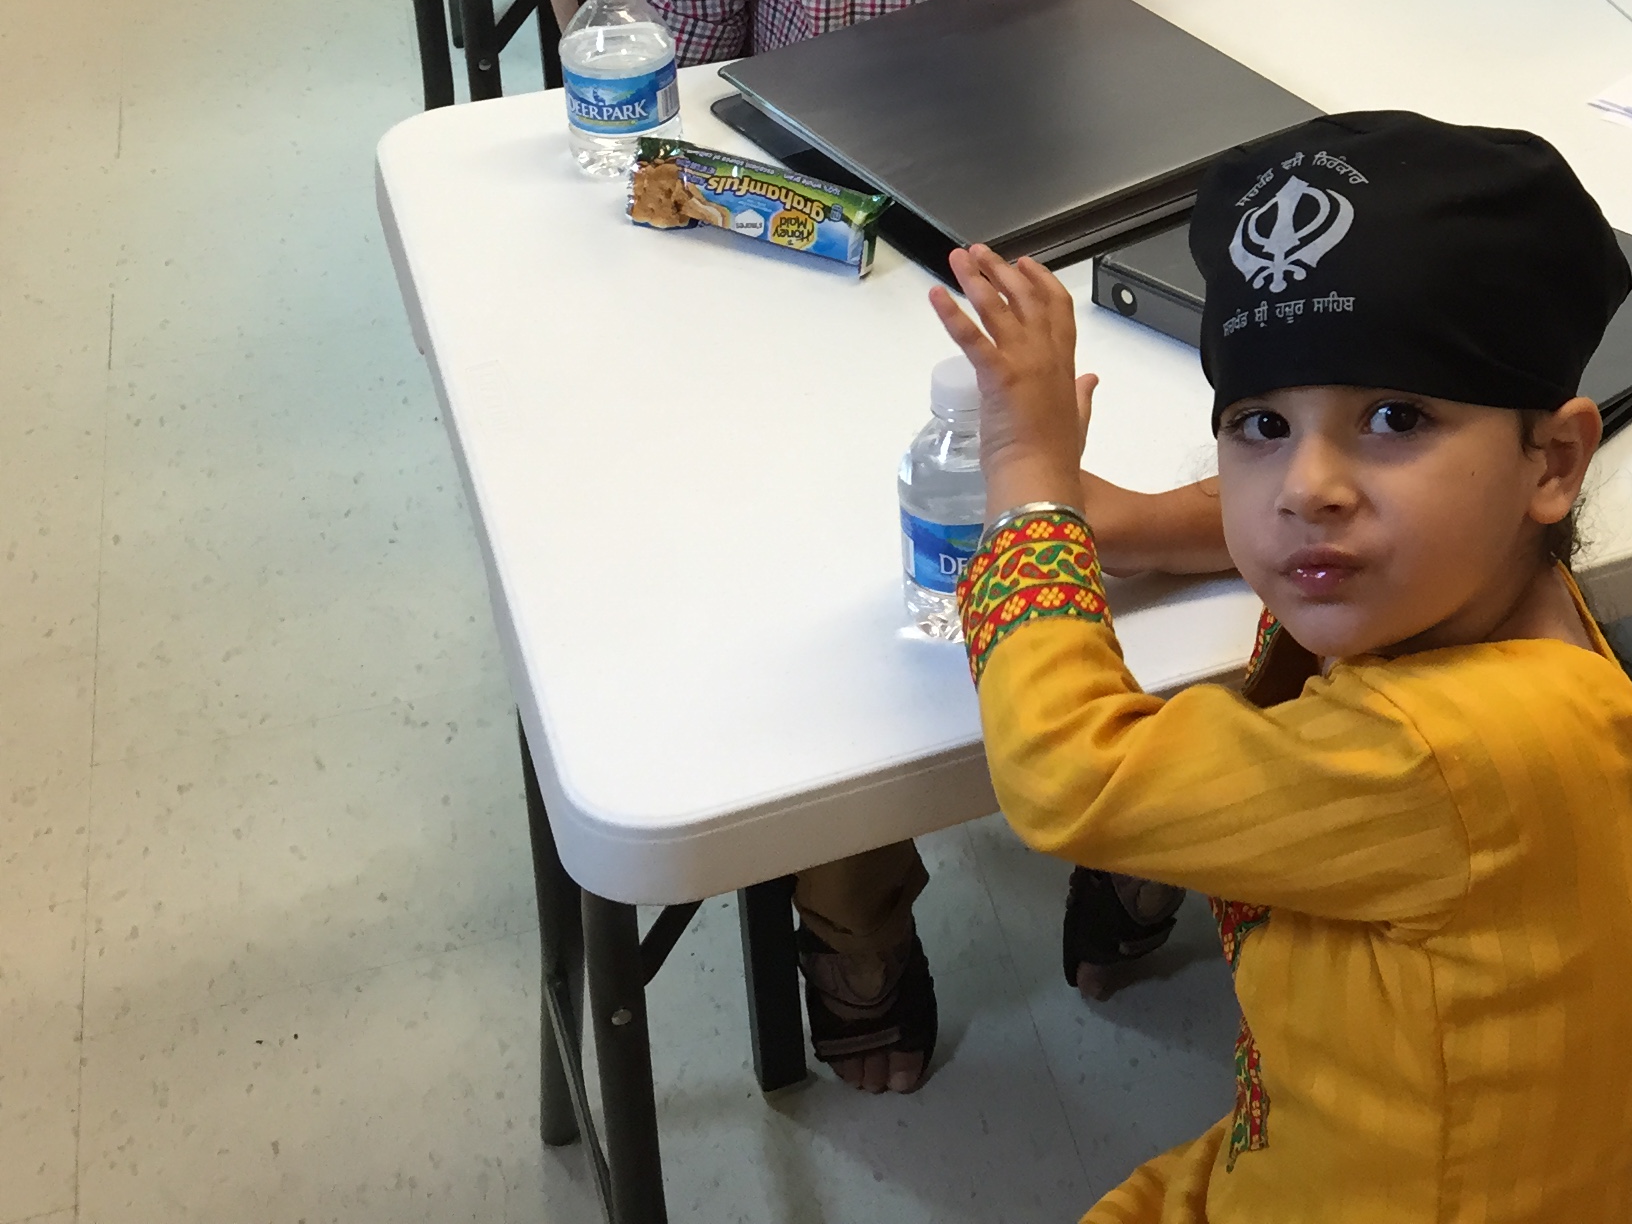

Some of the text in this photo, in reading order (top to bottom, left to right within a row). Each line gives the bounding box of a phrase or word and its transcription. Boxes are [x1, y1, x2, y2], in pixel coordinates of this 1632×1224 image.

[569, 96, 602, 120] DEER
[603, 99, 648, 121] PARK
[1312, 149, 1370, 186] ਨਿਰੰਕਾਰ
[708, 175, 825, 223] grahamfuls
[772, 223, 814, 245] Honey
[778, 213, 808, 232] Maid
[1312, 290, 1356, 314] ਸਾਹਿਬ
[938, 552, 968, 576] DE
